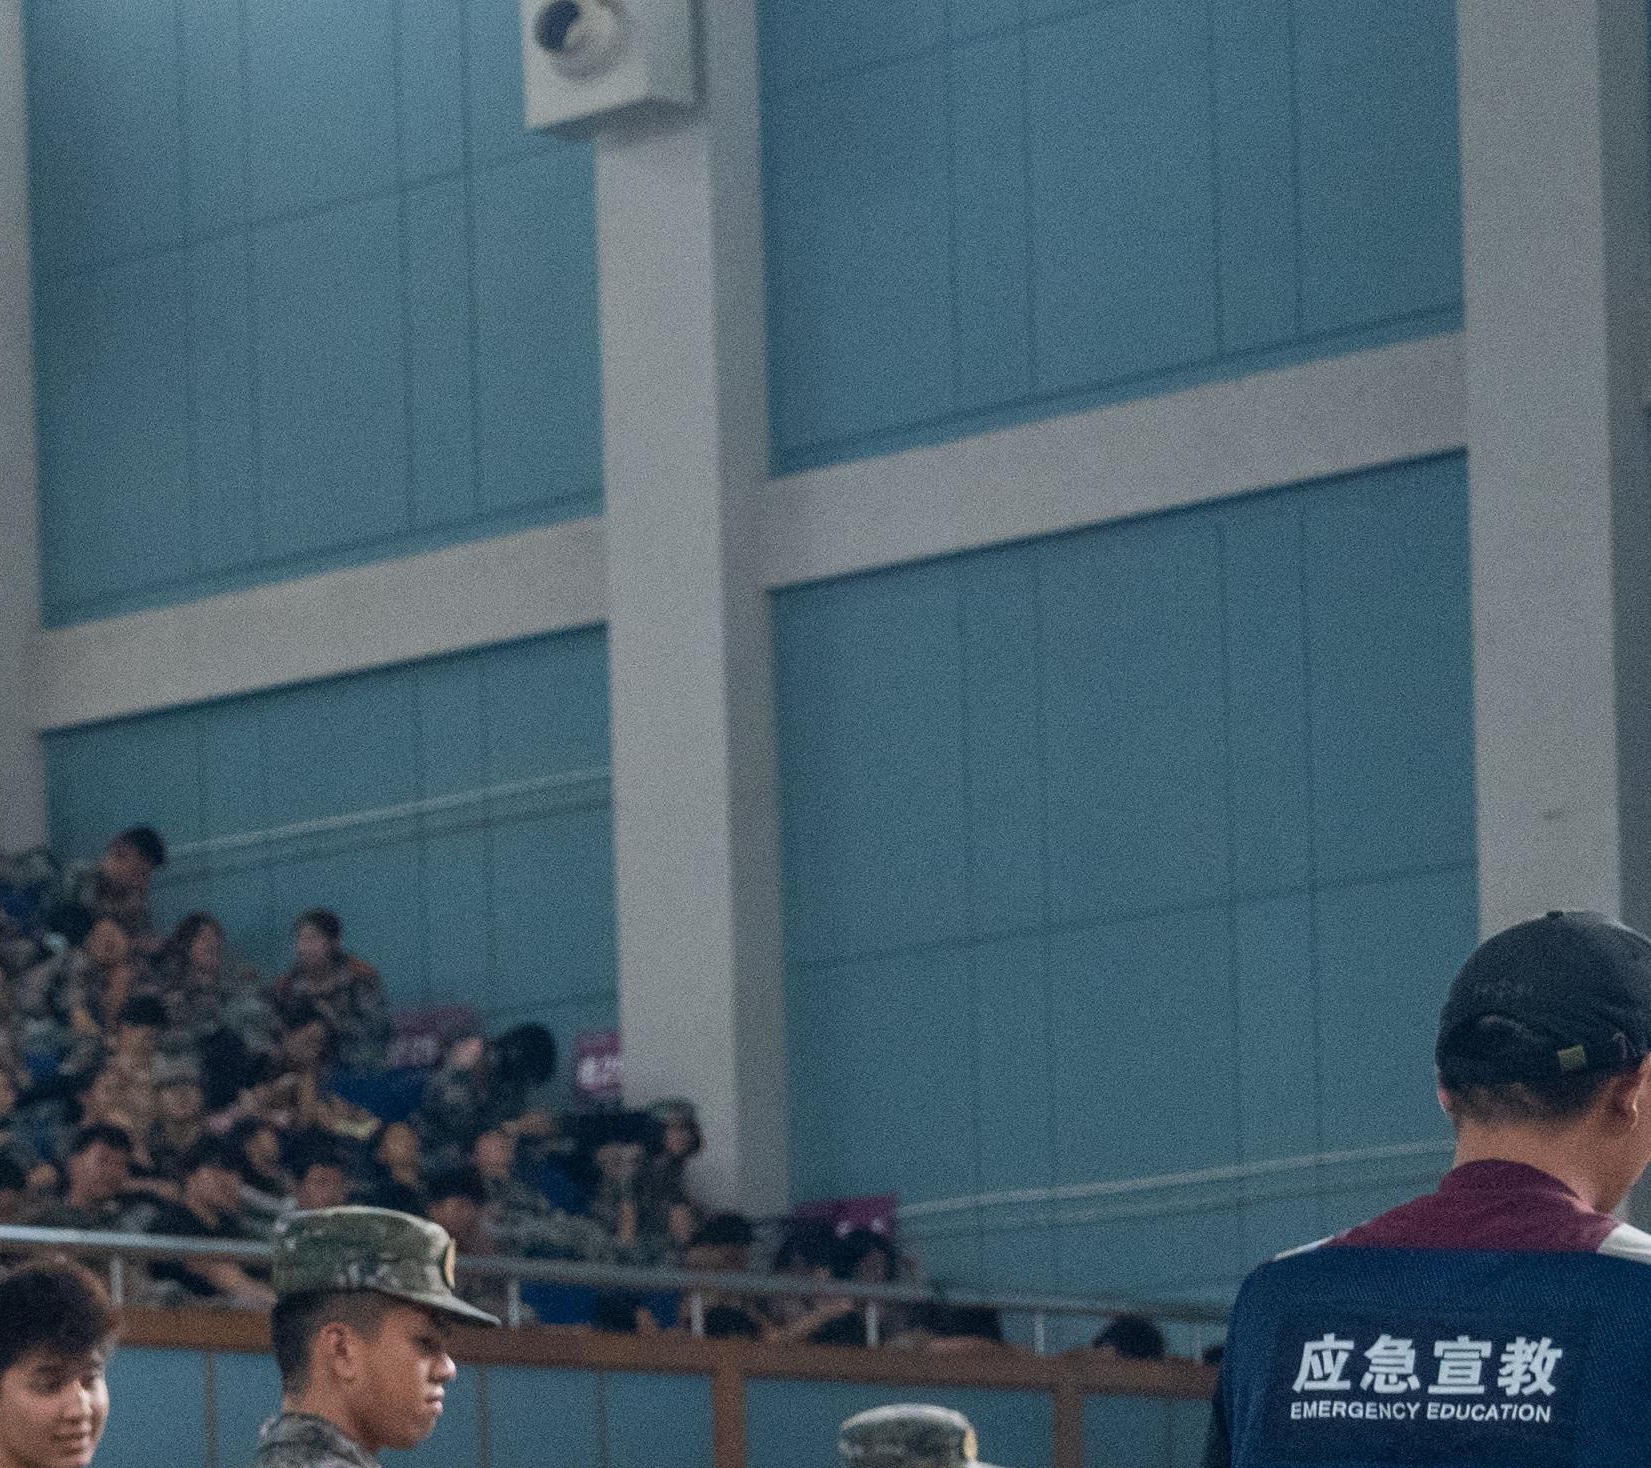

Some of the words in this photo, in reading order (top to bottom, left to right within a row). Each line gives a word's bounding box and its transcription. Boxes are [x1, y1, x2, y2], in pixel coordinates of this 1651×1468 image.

[1292, 1332, 1563, 1397] 应急宣教
[1290, 1400, 1420, 1420] EMERGENCY
[1426, 1403, 1551, 1424] EDUCATION
